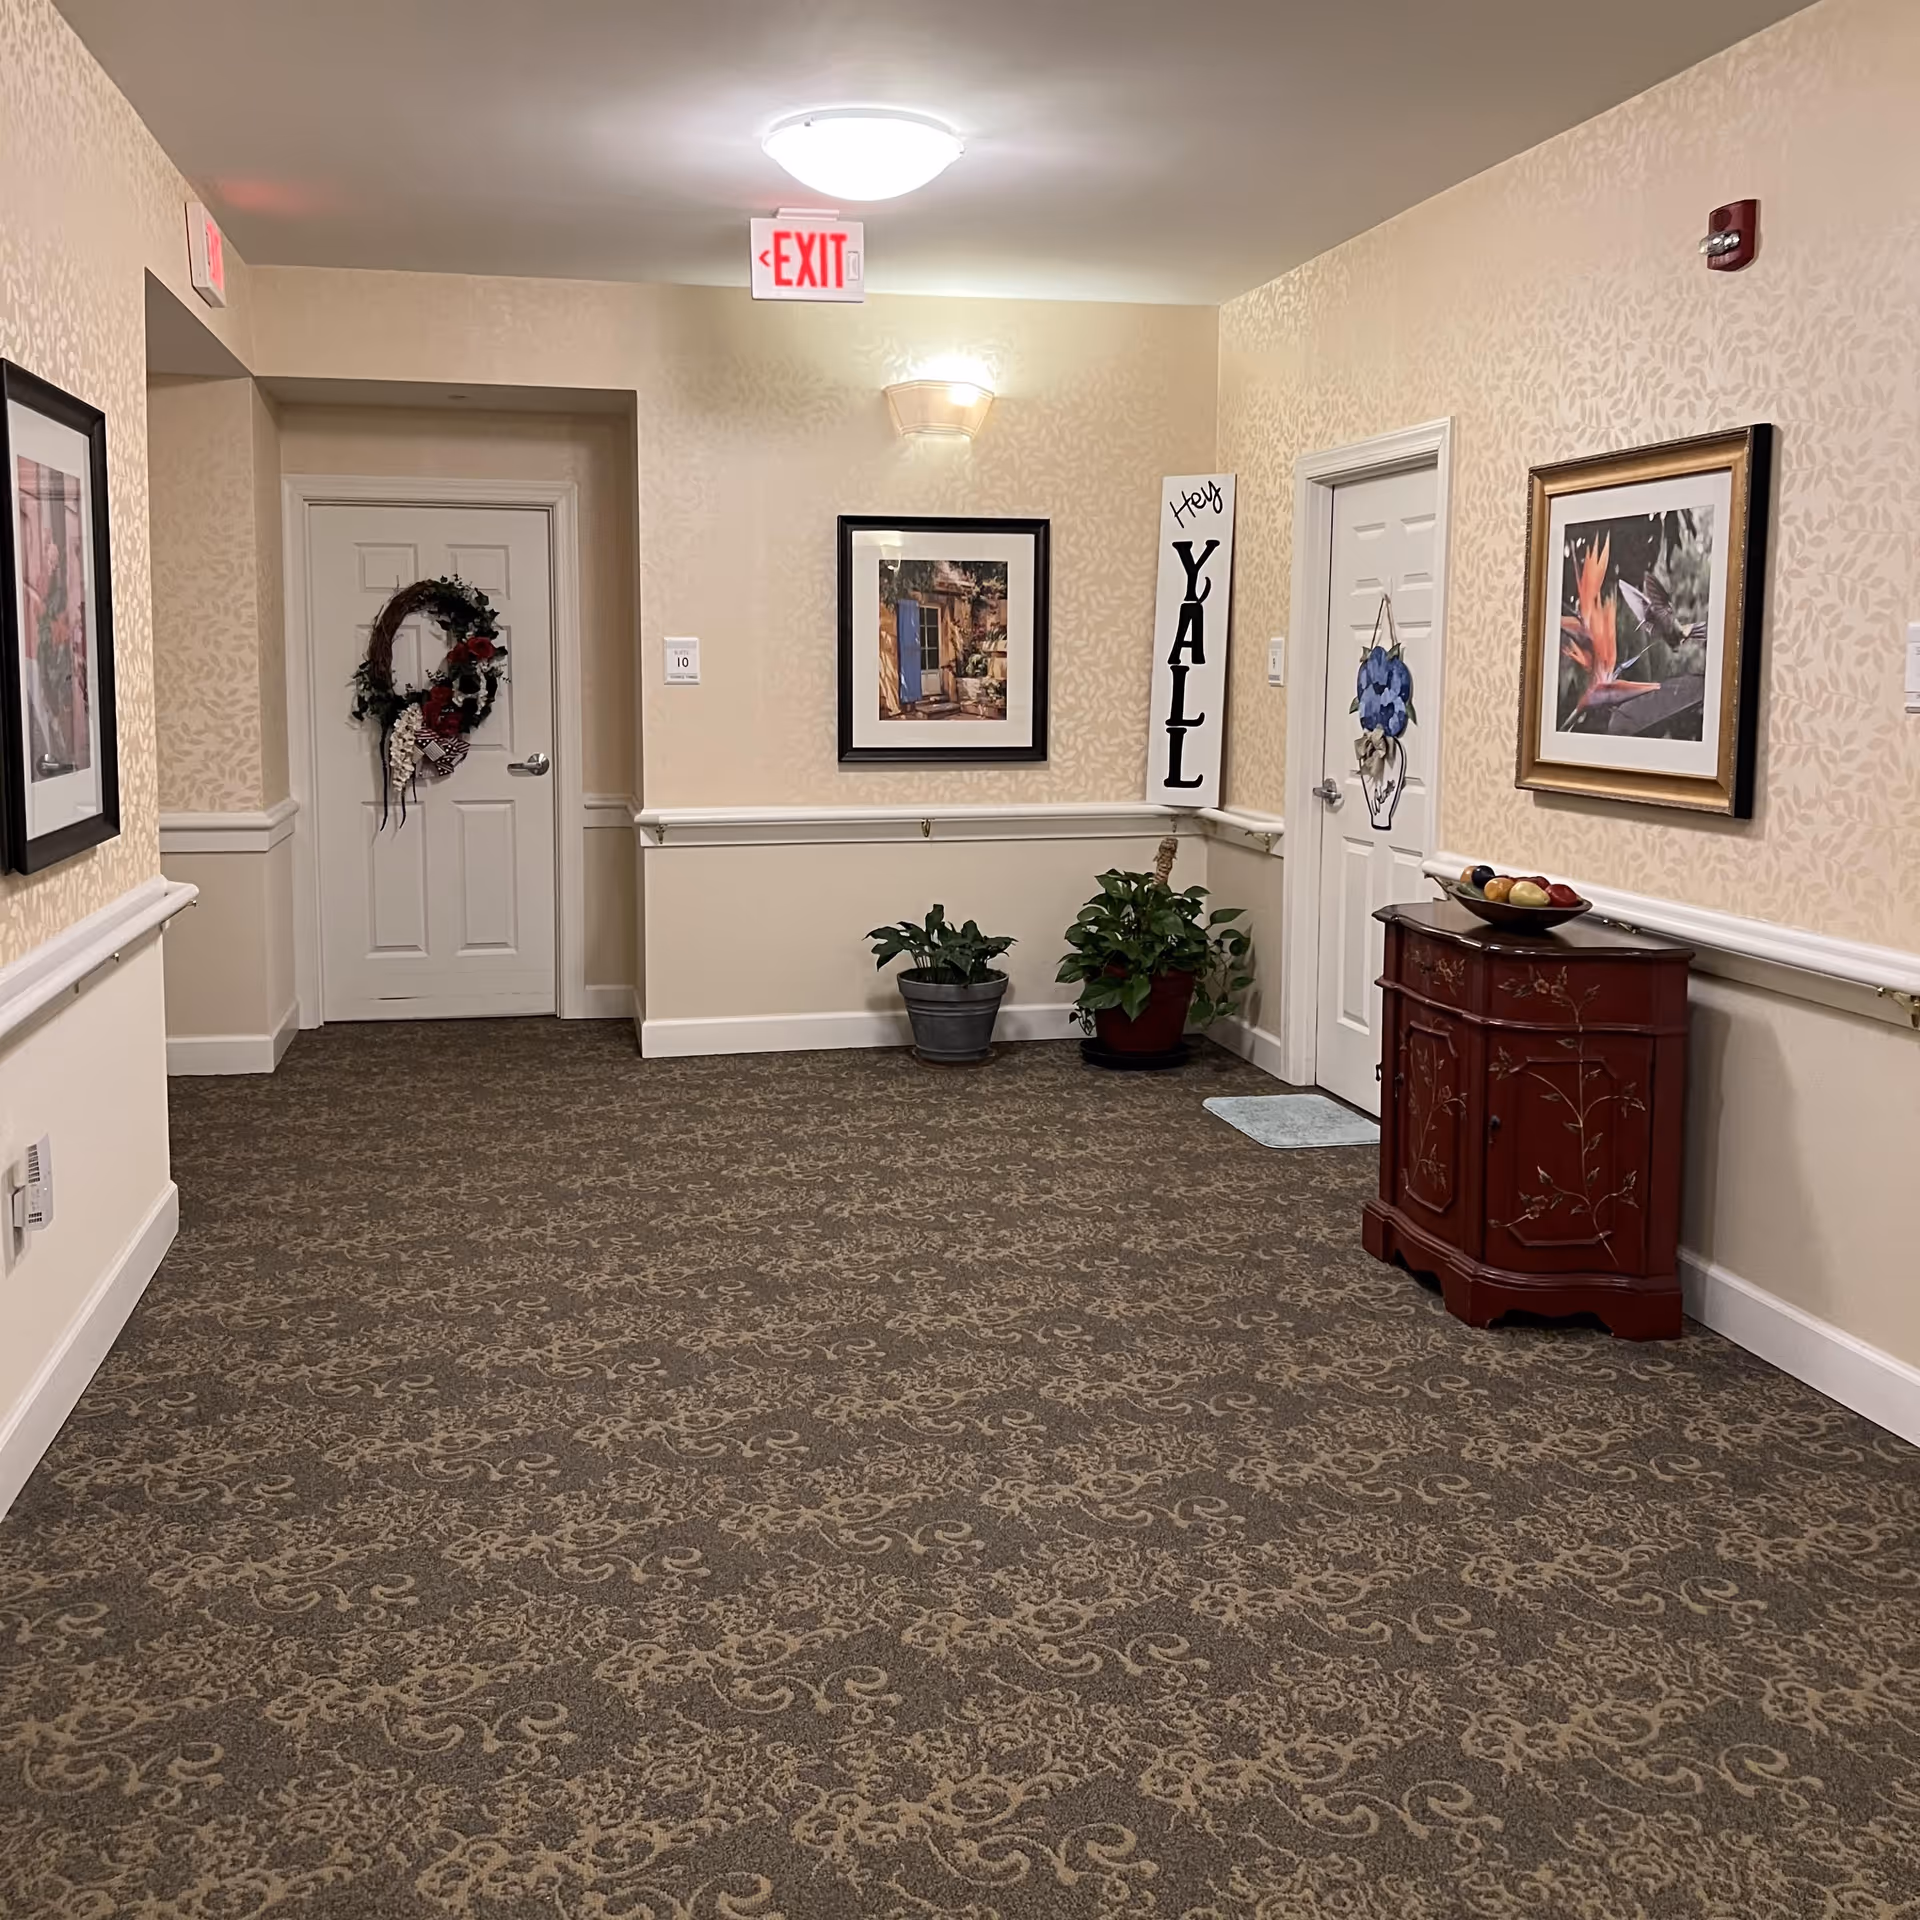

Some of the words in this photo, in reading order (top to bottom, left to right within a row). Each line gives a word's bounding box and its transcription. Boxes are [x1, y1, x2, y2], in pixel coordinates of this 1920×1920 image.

[773, 231, 847, 288] EXIT
[1169, 480, 1223, 529] Hey
[677, 656, 689, 668] 10
